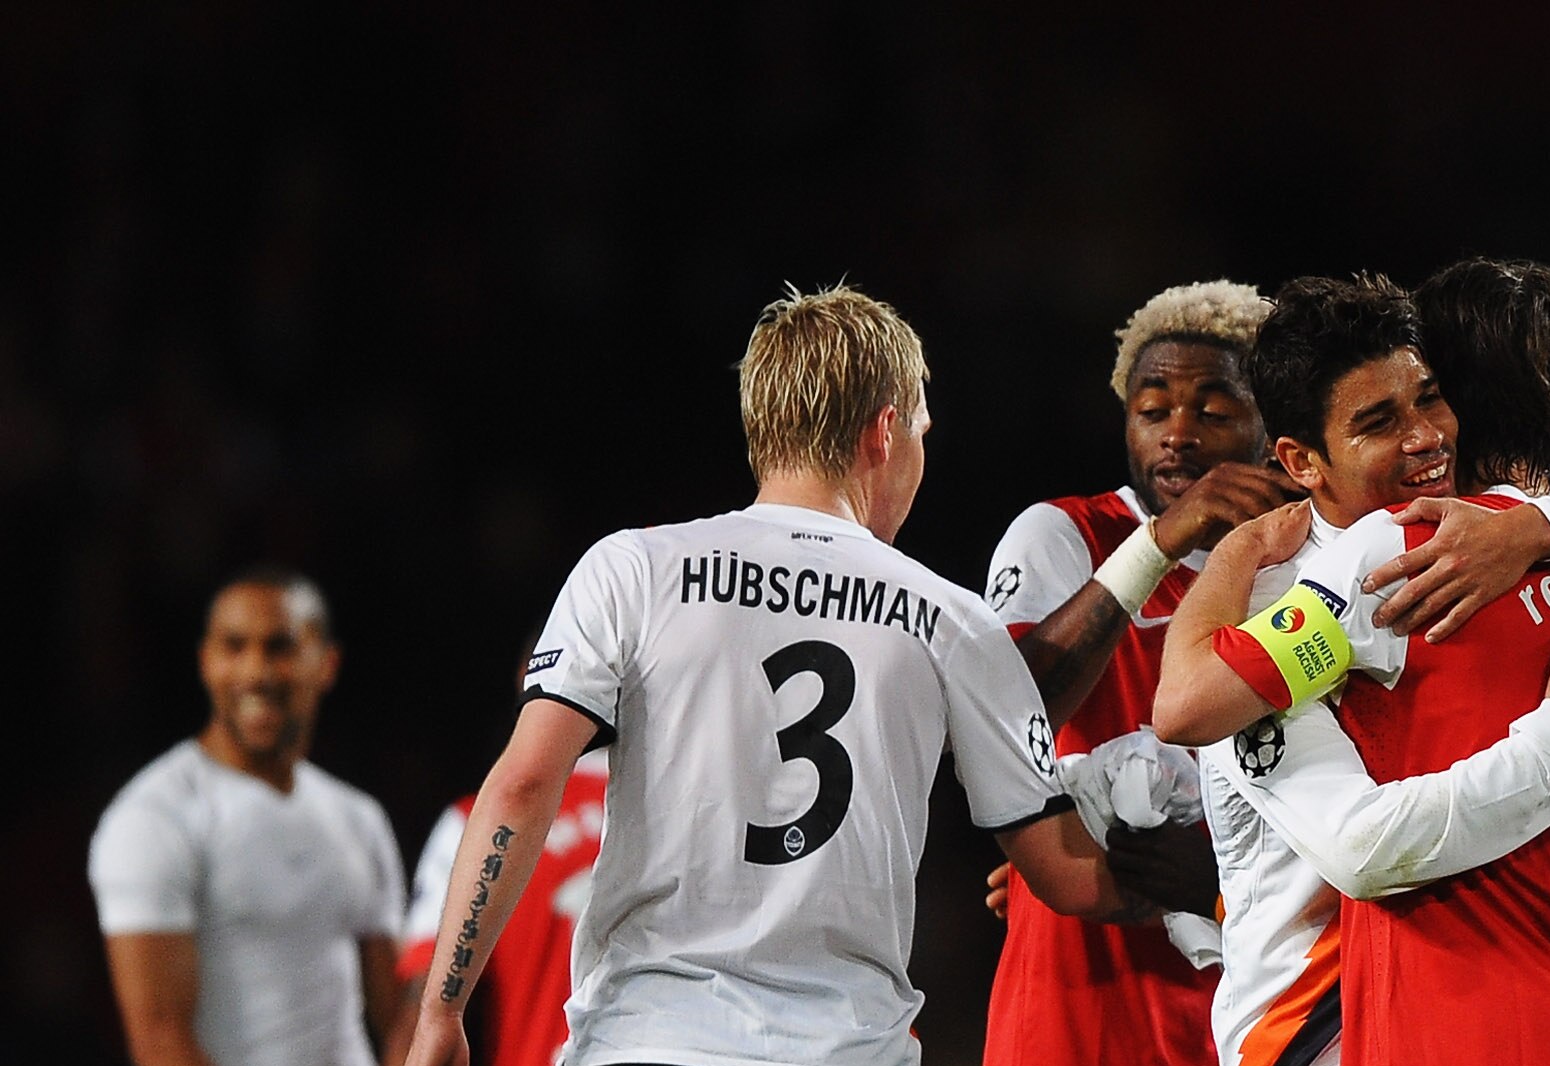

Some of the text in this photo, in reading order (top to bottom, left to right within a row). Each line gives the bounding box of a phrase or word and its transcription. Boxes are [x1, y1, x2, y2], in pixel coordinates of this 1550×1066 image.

[681, 549, 941, 645] HÜBSCHMAN
[1292, 644, 1317, 682] RACISM
[1301, 640, 1326, 675] AGAINST
[1312, 630, 1337, 670] UNITE
[744, 639, 857, 866] 3
